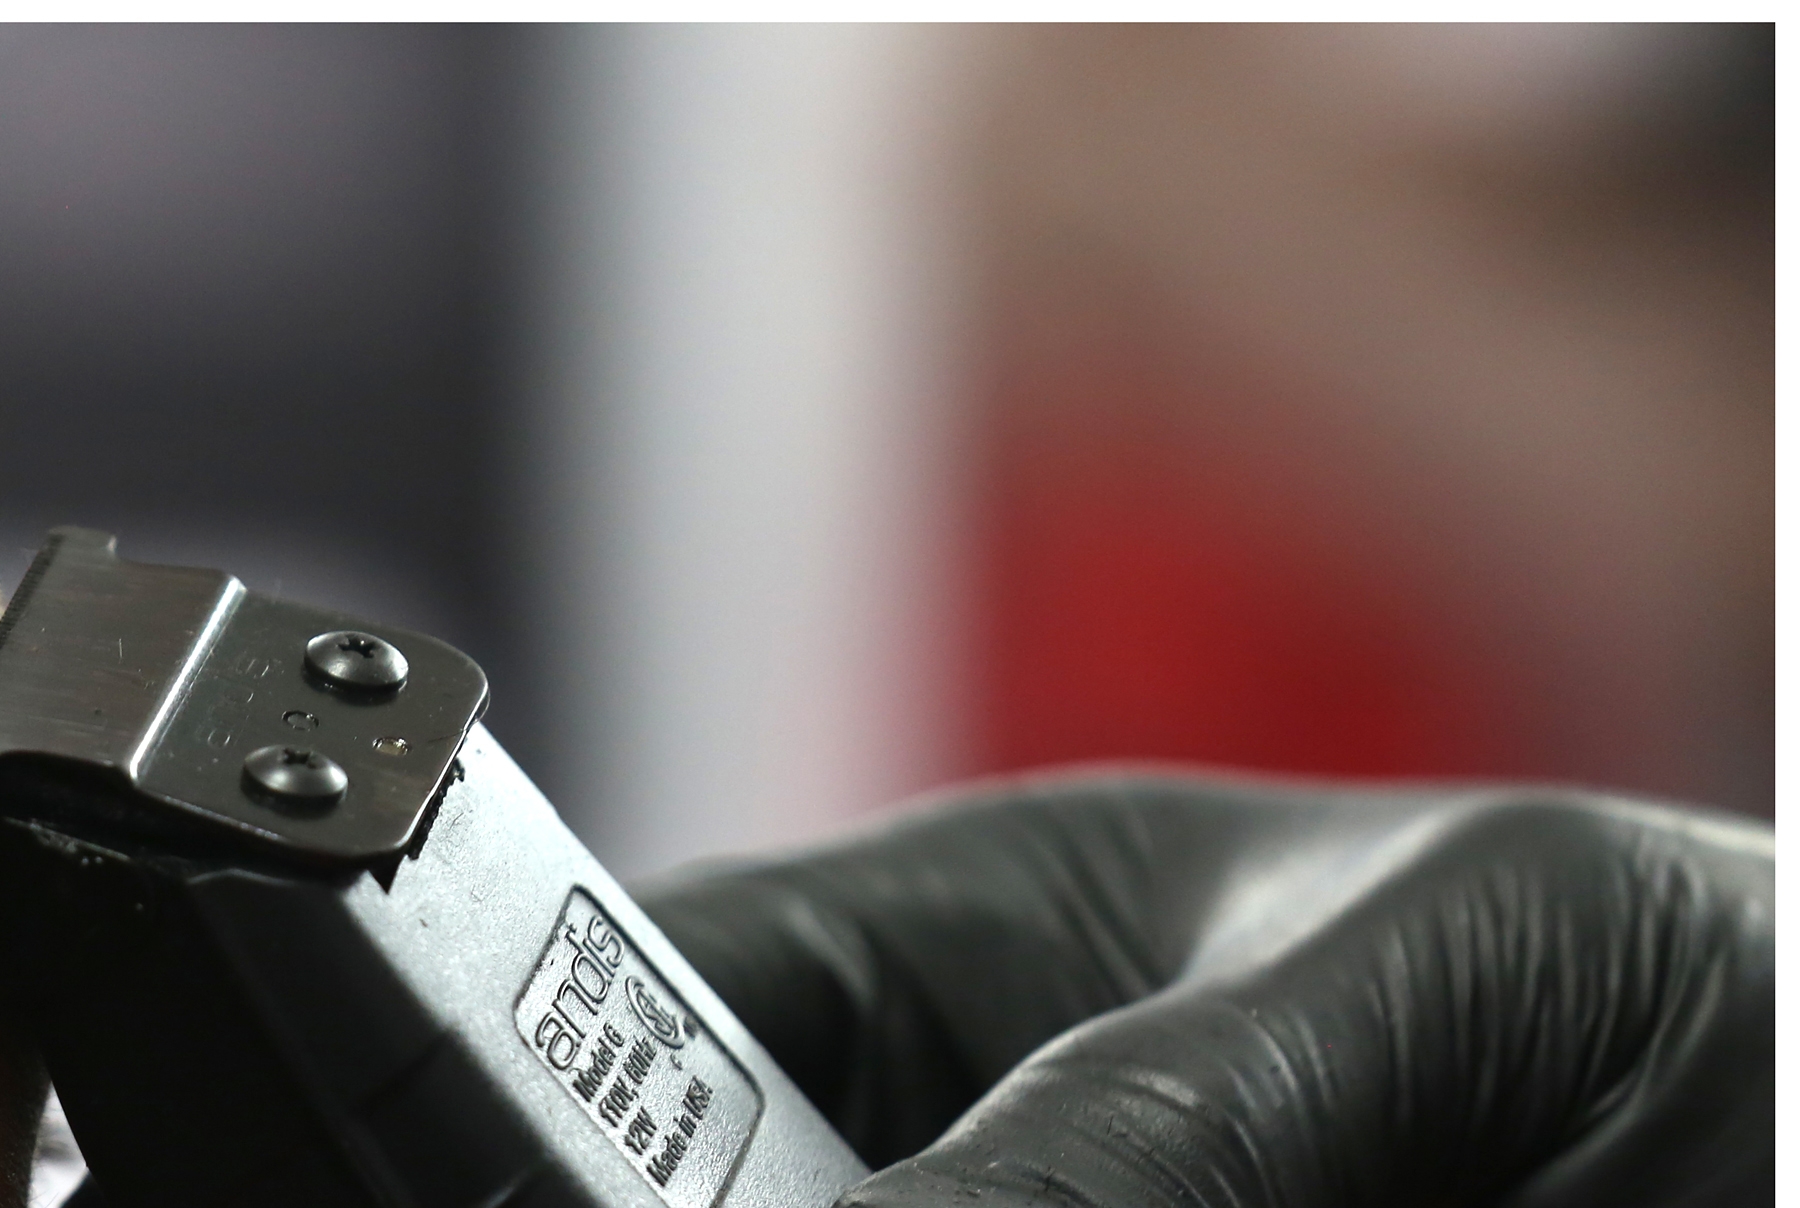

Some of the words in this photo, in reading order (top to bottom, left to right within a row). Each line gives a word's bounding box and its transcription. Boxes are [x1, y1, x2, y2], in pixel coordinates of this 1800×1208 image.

[535, 914, 625, 1070] andis
[573, 1037, 617, 1102] Model
[603, 1022, 624, 1047] G
[623, 1036, 657, 1085] 60Hz
[623, 1106, 657, 1156] 12W
[646, 1132, 687, 1187] Made
[673, 1113, 697, 1138] in
